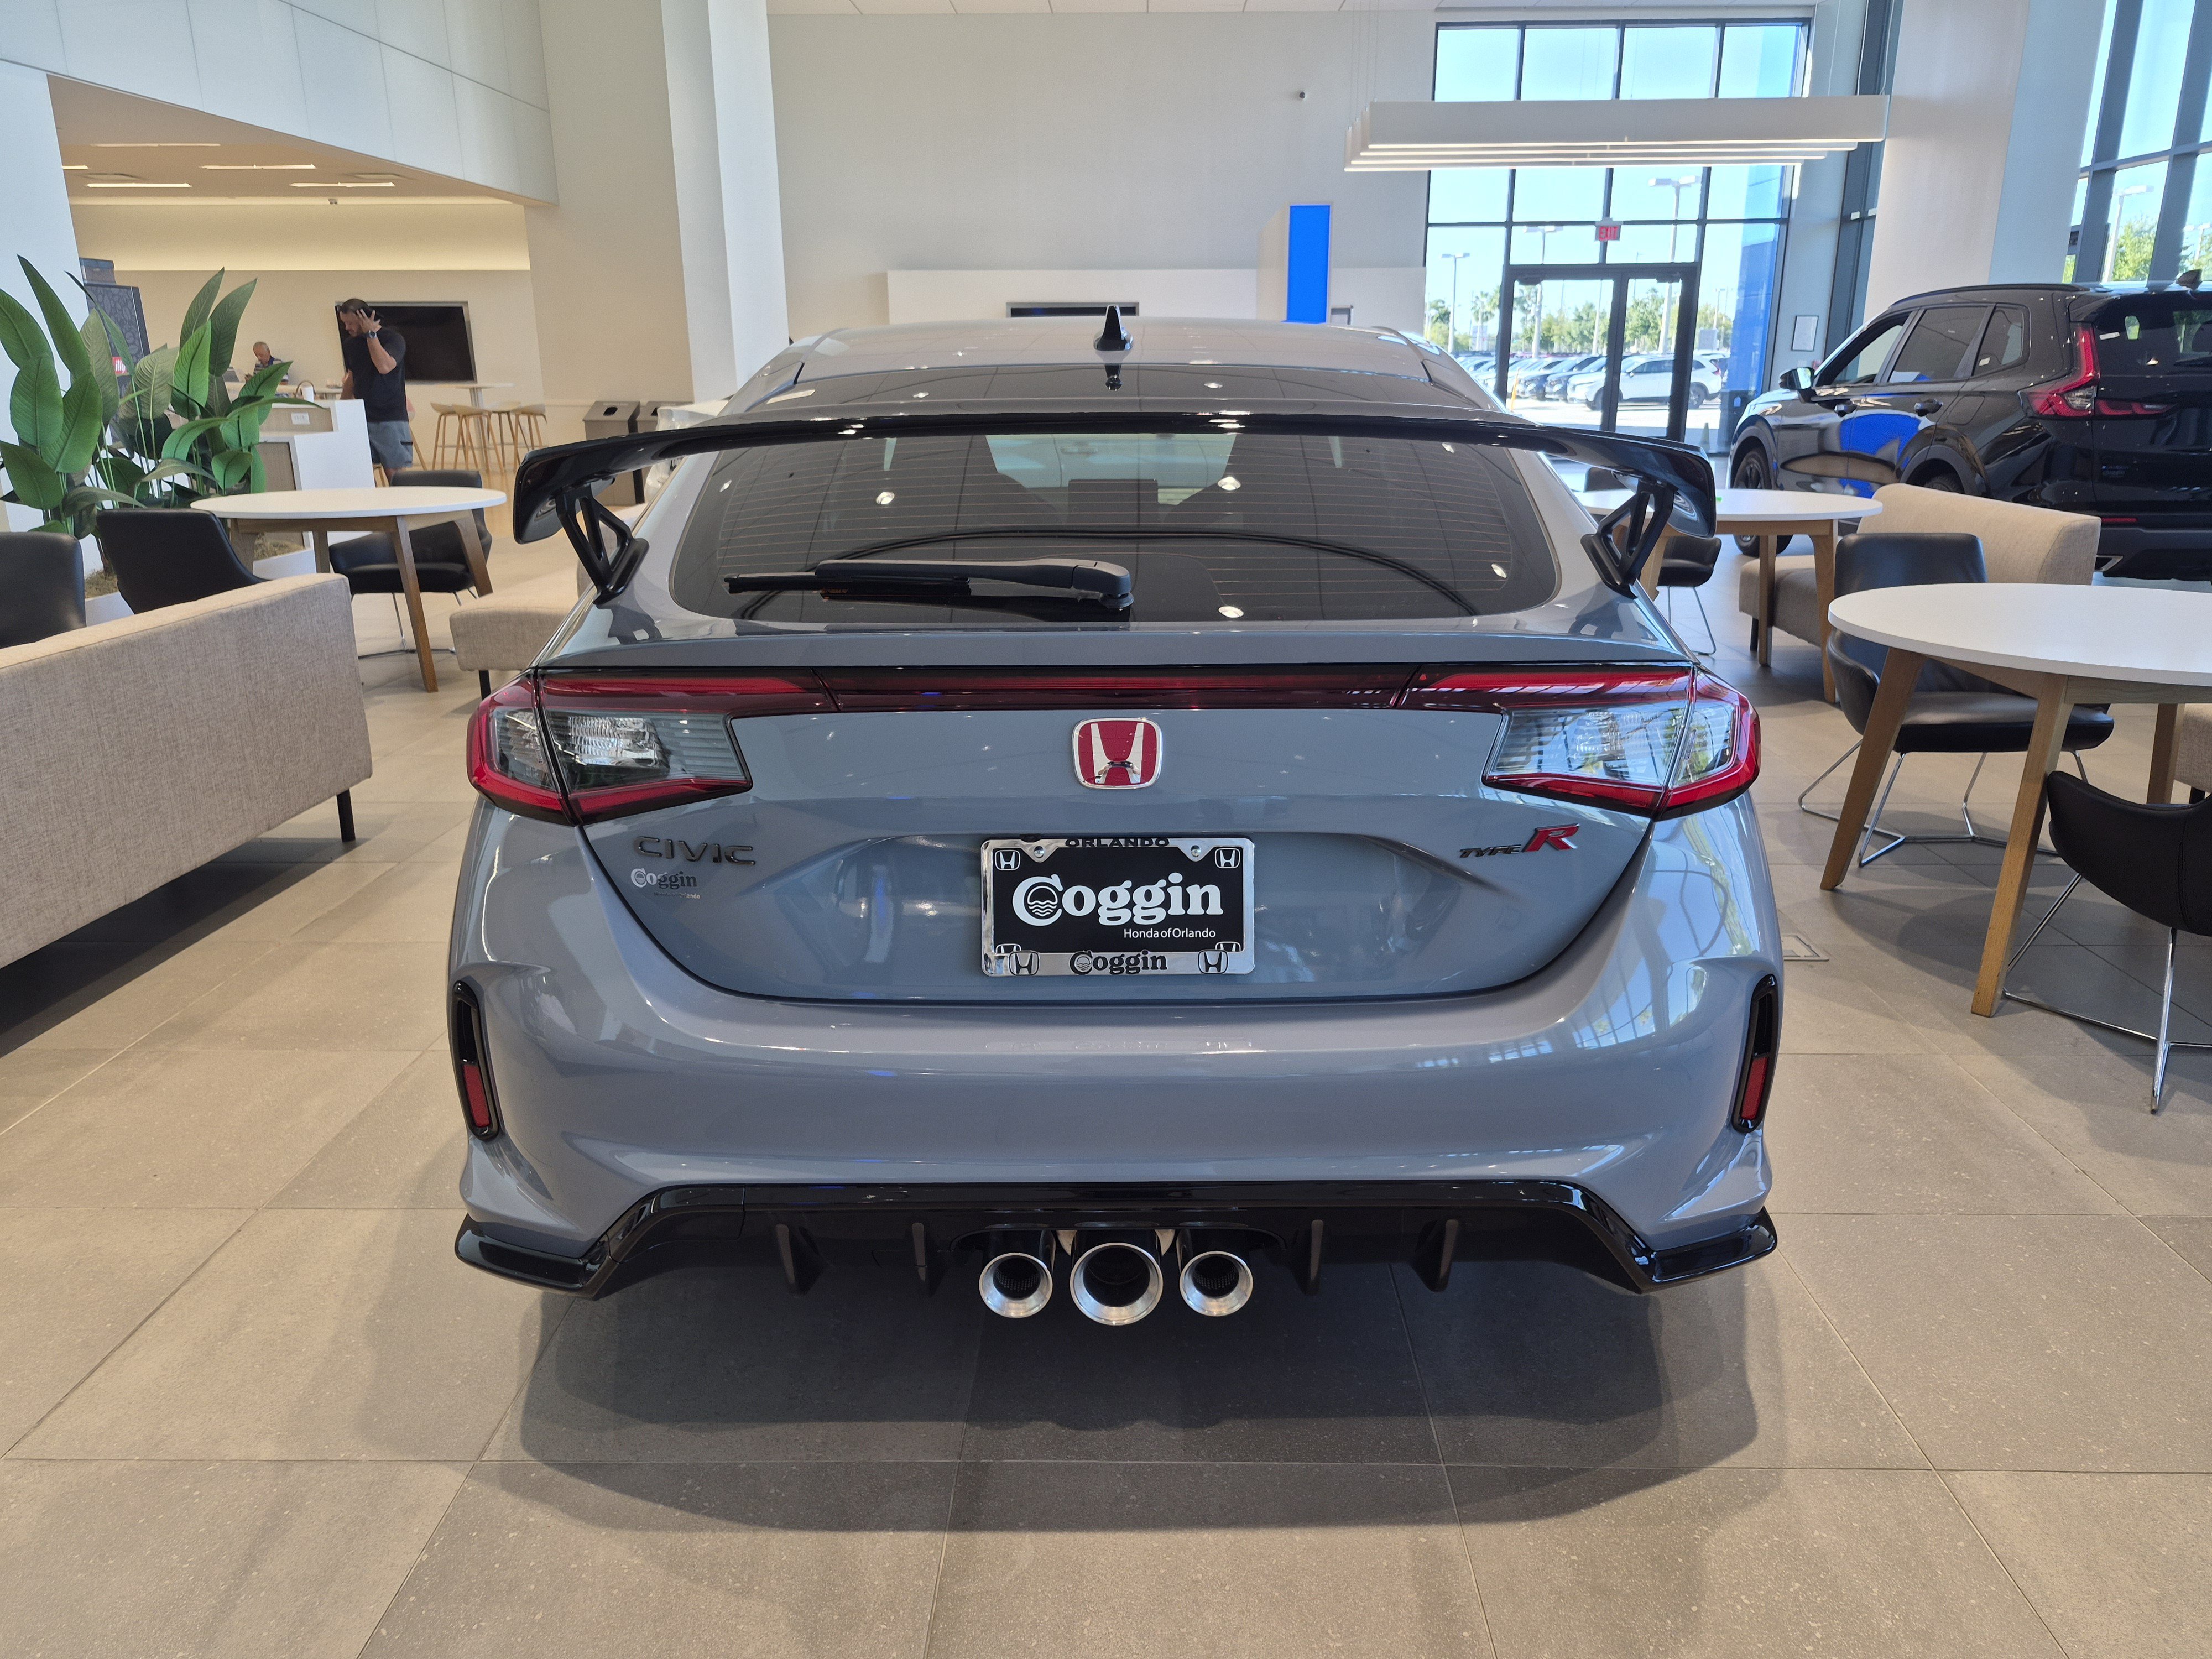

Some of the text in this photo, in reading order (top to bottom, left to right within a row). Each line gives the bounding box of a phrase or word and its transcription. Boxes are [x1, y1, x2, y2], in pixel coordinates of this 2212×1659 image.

[1598, 227, 1619, 241] EXIT
[634, 836, 756, 865] CIVIC
[1065, 838, 1170, 847] ORLANDO
[1459, 823, 1580, 858] TYPE R
[630, 868, 698, 889] Coggin
[1012, 872, 1224, 926] Coggin
[1124, 927, 1216, 938] Honda of Orlando
[1070, 950, 1168, 975] Coggin
